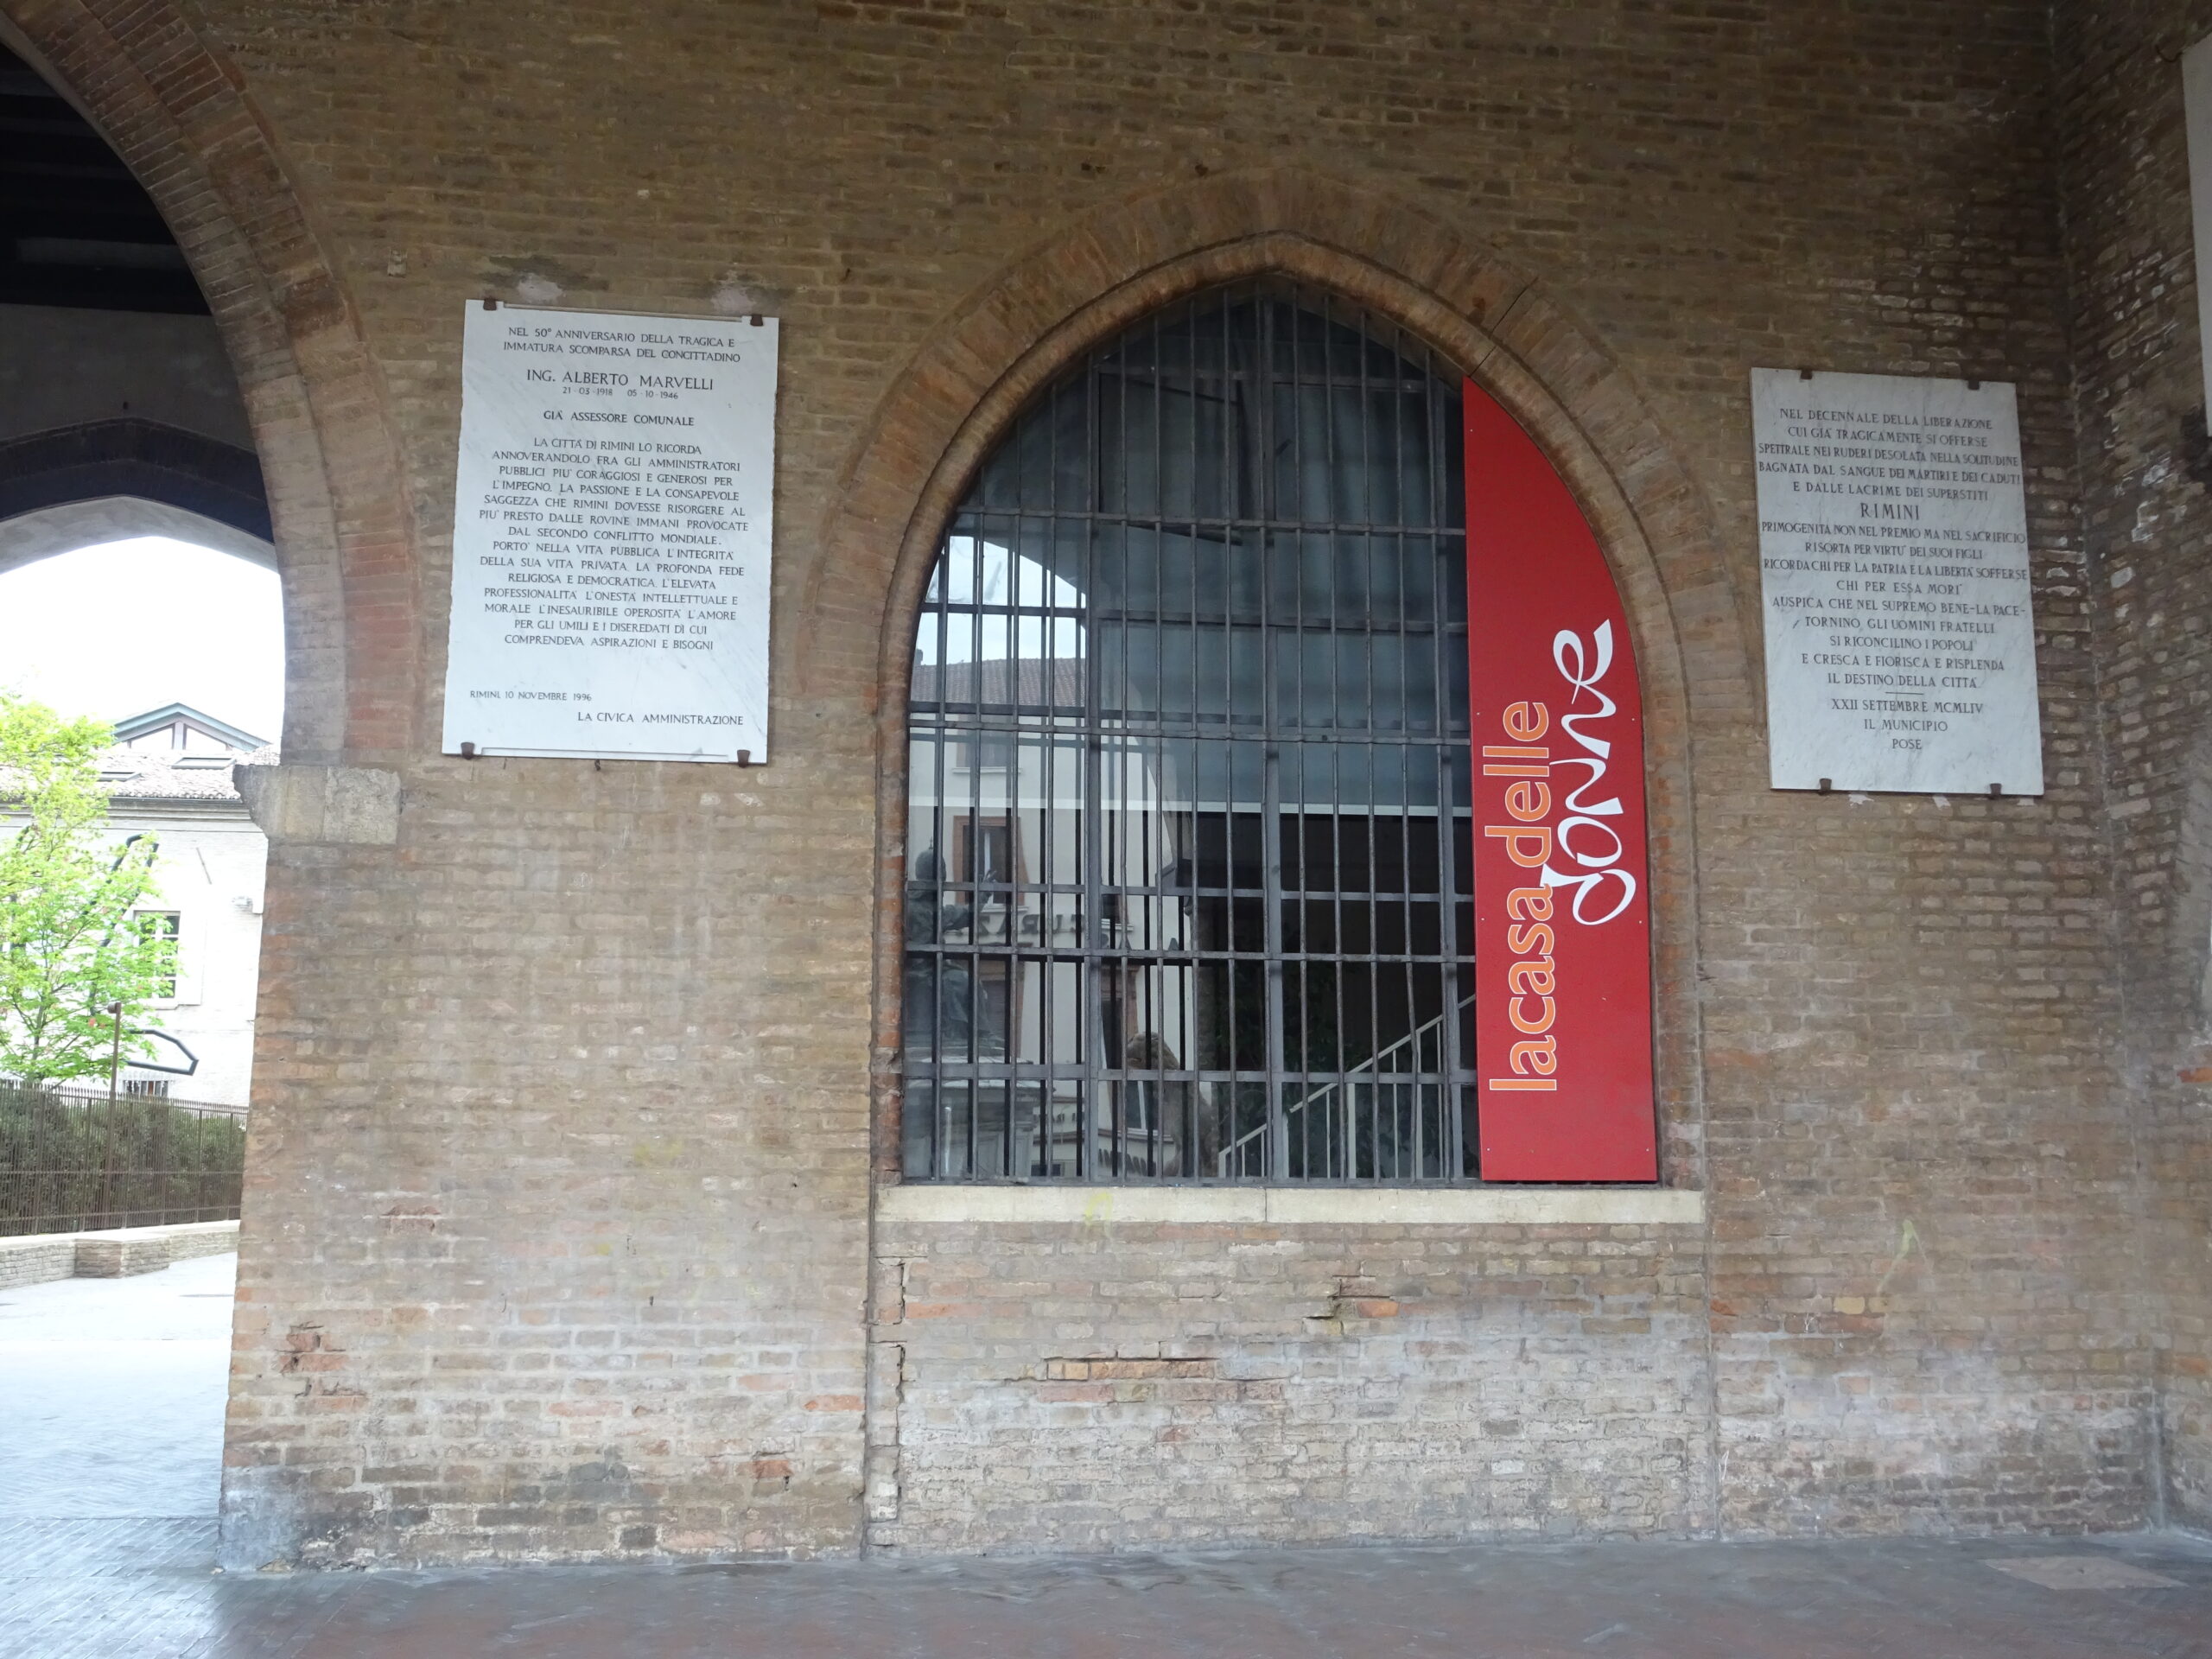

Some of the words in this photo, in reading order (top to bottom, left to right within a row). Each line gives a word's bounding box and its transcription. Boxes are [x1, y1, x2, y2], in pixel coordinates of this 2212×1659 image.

[508, 327, 529, 336] NEL
[555, 328, 635, 342] ANNIVERSARIO
[640, 334, 673, 344] DELLA
[678, 335, 724, 346] TRAGICA
[504, 341, 563, 353] IMMATURA
[569, 344, 631, 357] SCOMPARSA
[636, 348, 656, 358] DEL
[661, 349, 741, 362] CONCITTADINO
[527, 369, 556, 382] ING.
[562, 371, 628, 385] ALBERTO
[639, 374, 713, 390] MARVELLI
[570, 411, 627, 423] ASSESSORE
[633, 414, 694, 426] COMUNALE
[1780, 408, 1802, 419] NEL
[1808, 410, 1878, 423] DECENNALE
[1883, 414, 1918, 425] DELLA
[1923, 416, 1992, 429] LIBERAZIONE
[534, 437, 548, 447] LA
[586, 440, 596, 449] DI
[601, 441, 634, 451] RIMINI
[639, 442, 652, 452] LO
[656, 443, 702, 454] RICORDA
[1788, 426, 1807, 436] CUI
[1836, 429, 1922, 443] TRAGICAMENTE
[1927, 434, 1936, 443] SI
[1939, 435, 1986, 447] OFFERSE
[492, 450, 590, 463] ANNOVERANDOLO
[596, 455, 618, 465] FRA
[624, 456, 640, 466] GLI
[648, 458, 740, 471] AMMINISTRATORI
[1758, 442, 1810, 455] SPETTRALE
[1813, 446, 1830, 456] NEI
[1833, 447, 1871, 458] RUDERI
[1874, 448, 1925, 461] DESOLATA
[1930, 452, 1960, 463] NELLA
[1962, 454, 2018, 466] SOLITUDINE
[499, 466, 544, 476] PUBBLICI
[575, 468, 639, 481] CORAGGIOSI
[657, 474, 707, 485] GENEROSI
[714, 476, 733, 486] PER
[1758, 461, 1809, 474] BAGNATA
[1813, 464, 1834, 475] DAL
[1840, 465, 1885, 477] SANGUE
[1889, 467, 1904, 478] DEI
[1907, 468, 1949, 480] MARTIRI
[1961, 471, 1978, 482] DEI
[1980, 473, 2020, 484] CADUTI
[559, 483, 574, 493] LA
[580, 484, 629, 495] PASSIONE
[645, 487, 661, 497] LA
[664, 488, 739, 500] CONSAPEVOLE
[1806, 481, 1843, 493] DALLE
[1848, 484, 1901, 496] LACRIME
[1905, 486, 1923, 497] DEI
[1927, 487, 1987, 500] SUPERSTITI
[484, 494, 539, 505] SAGGEZZA
[544, 497, 566, 507] CHE
[573, 499, 607, 509] RIMINI
[614, 501, 660, 512] DOVESSE
[667, 504, 724, 515] RISORGERE
[730, 507, 745, 516] AL
[1859, 502, 1919, 520] RIMINI
[503, 511, 543, 521] PRESTO
[549, 512, 583, 524] DALLE
[589, 514, 629, 525] ROVINE
[637, 518, 678, 528] IMMANI
[686, 519, 748, 531] PROVOCATE
[508, 526, 531, 536] DAL
[537, 527, 588, 538] SECONDO
[594, 530, 654, 542] CONFLITTO
[1761, 521, 1831, 534] PRIMOGENITA
[1834, 524, 1856, 535] NON
[1859, 525, 1878, 537] NEL
[1880, 526, 1921, 538] PREMIO
[1923, 529, 1939, 538] MA
[1943, 530, 1961, 540] NEL
[1965, 530, 2025, 543] SACRIFICIO
[536, 543, 570, 553] NELLA
[575, 544, 603, 554] VITA
[610, 546, 660, 556] PUBBLICA
[1805, 541, 1850, 554] RISORTA
[1853, 543, 1871, 554] PER
[1910, 546, 1926, 556] DEI
[1929, 547, 1953, 558] SUOI
[1955, 549, 1982, 559] FIGLI
[480, 556, 514, 566] DELLA
[520, 557, 541, 567] SUA
[546, 558, 573, 569] VITA
[636, 562, 650, 571] LA
[656, 563, 712, 575] PROFONDA
[718, 566, 744, 575] FEDE
[1764, 558, 1809, 570] RICORDA
[1811, 560, 1830, 571] CHI
[1833, 561, 1851, 572] PER
[1854, 562, 1868, 572] LA
[1872, 563, 1907, 574] PATRIA
[1917, 565, 1932, 575] LA
[1975, 567, 2026, 580] SOFFERSE
[508, 572, 562, 583] RELIGIOSA
[1836, 580, 1858, 590] CHI
[1865, 581, 1885, 592] PER
[1893, 582, 1922, 594] ESSA
[643, 593, 727, 605] INTELLETTUALE
[1771, 595, 1823, 608] AUSPICA
[1828, 598, 1853, 609] CHE
[1856, 599, 1878, 610] NEL
[1881, 600, 1936, 613] SUPREMO
[514, 619, 534, 628] PER
[537, 620, 554, 629] GLI
[559, 620, 588, 630] UMILI
[609, 622, 669, 633] DISEREDATI
[689, 625, 706, 634] CUI
[1805, 616, 1860, 628] TORNINO
[1866, 618, 1887, 629] GLI
[1891, 620, 1935, 631] UOMINI
[1940, 621, 1994, 633] FRATELLI
[504, 633, 584, 645] COMPRENDEVA
[590, 637, 656, 648] ASPIRAZIONI
[672, 639, 713, 650] BISOGNI
[1829, 635, 1840, 645] SI
[1844, 636, 1922, 649] RICONCILINO
[1931, 639, 1973, 651] POPOLI
[1813, 653, 1859, 665] CRESCA
[1875, 656, 1929, 668] FIORISCA
[1945, 658, 2004, 671] RISPLENDA
[1827, 672, 1840, 683] IL
[1844, 673, 1897, 685] DESTINO
[1898, 675, 1936, 687] DELLA
[518, 691, 567, 700] NOVEMBRE
[1831, 698, 1858, 709] XXII
[1862, 698, 1928, 713] SETTEMBRE
[1933, 702, 1983, 714] MCMLIV
[577, 712, 593, 721] LA
[596, 712, 633, 722] CIVICA
[642, 713, 743, 726] AMMINISTRAZIONE
[1864, 718, 1875, 729] IL
[1880, 718, 1948, 731] MUNICIPIO
[1891, 738, 1923, 750] POSE
[1483, 701, 1551, 868] delle
